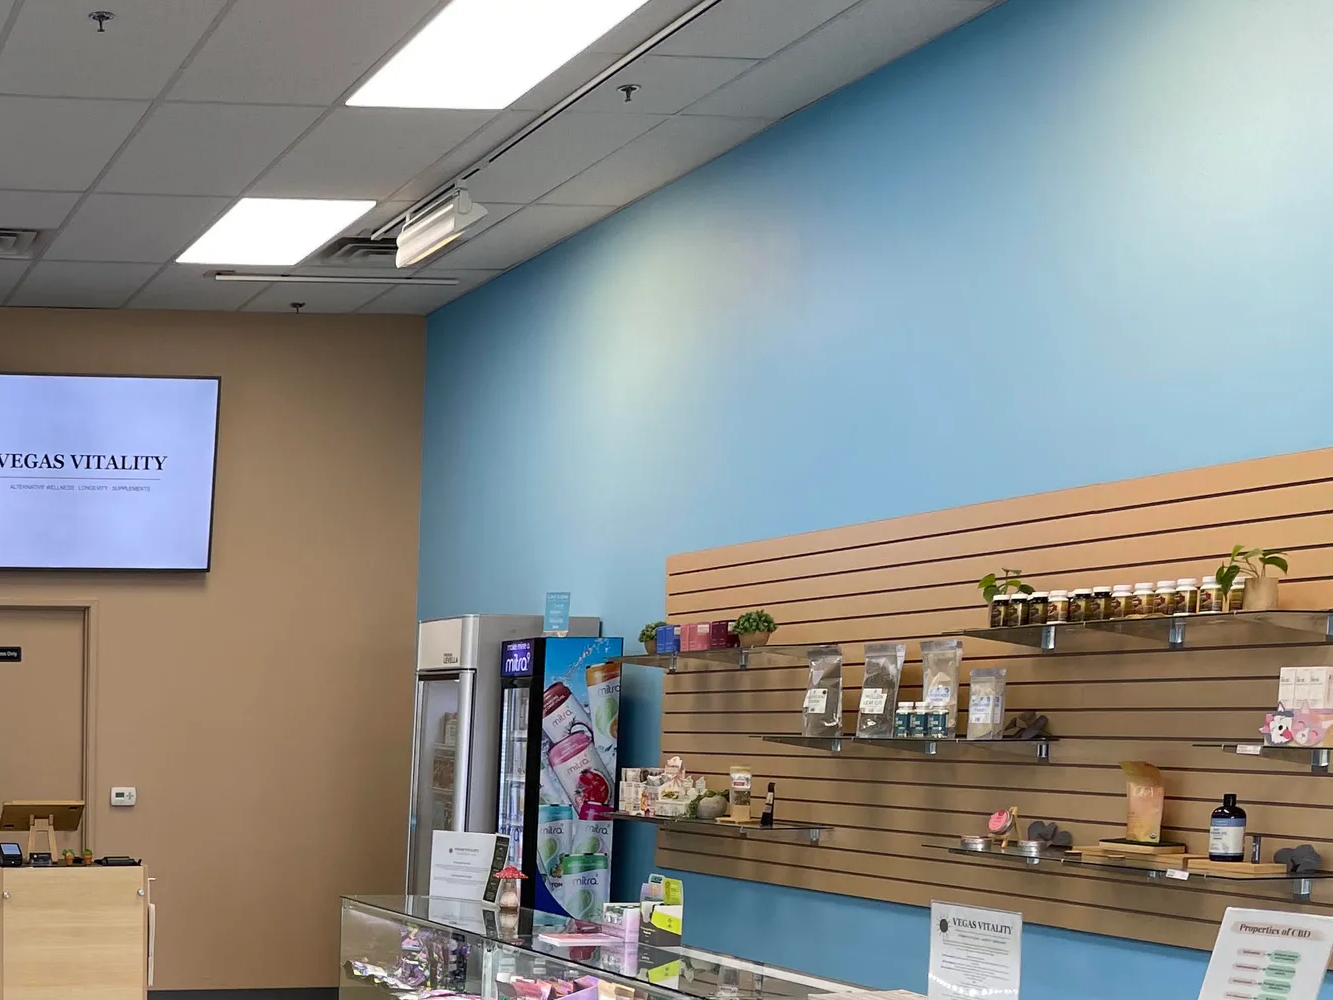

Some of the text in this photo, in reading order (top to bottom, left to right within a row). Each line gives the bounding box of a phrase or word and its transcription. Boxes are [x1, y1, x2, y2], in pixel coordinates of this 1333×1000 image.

[70, 454, 168, 471] VITALITY
[952, 917, 1013, 935] VEGAS VITALITY
[1239, 923, 1311, 939] Properties of CBD
